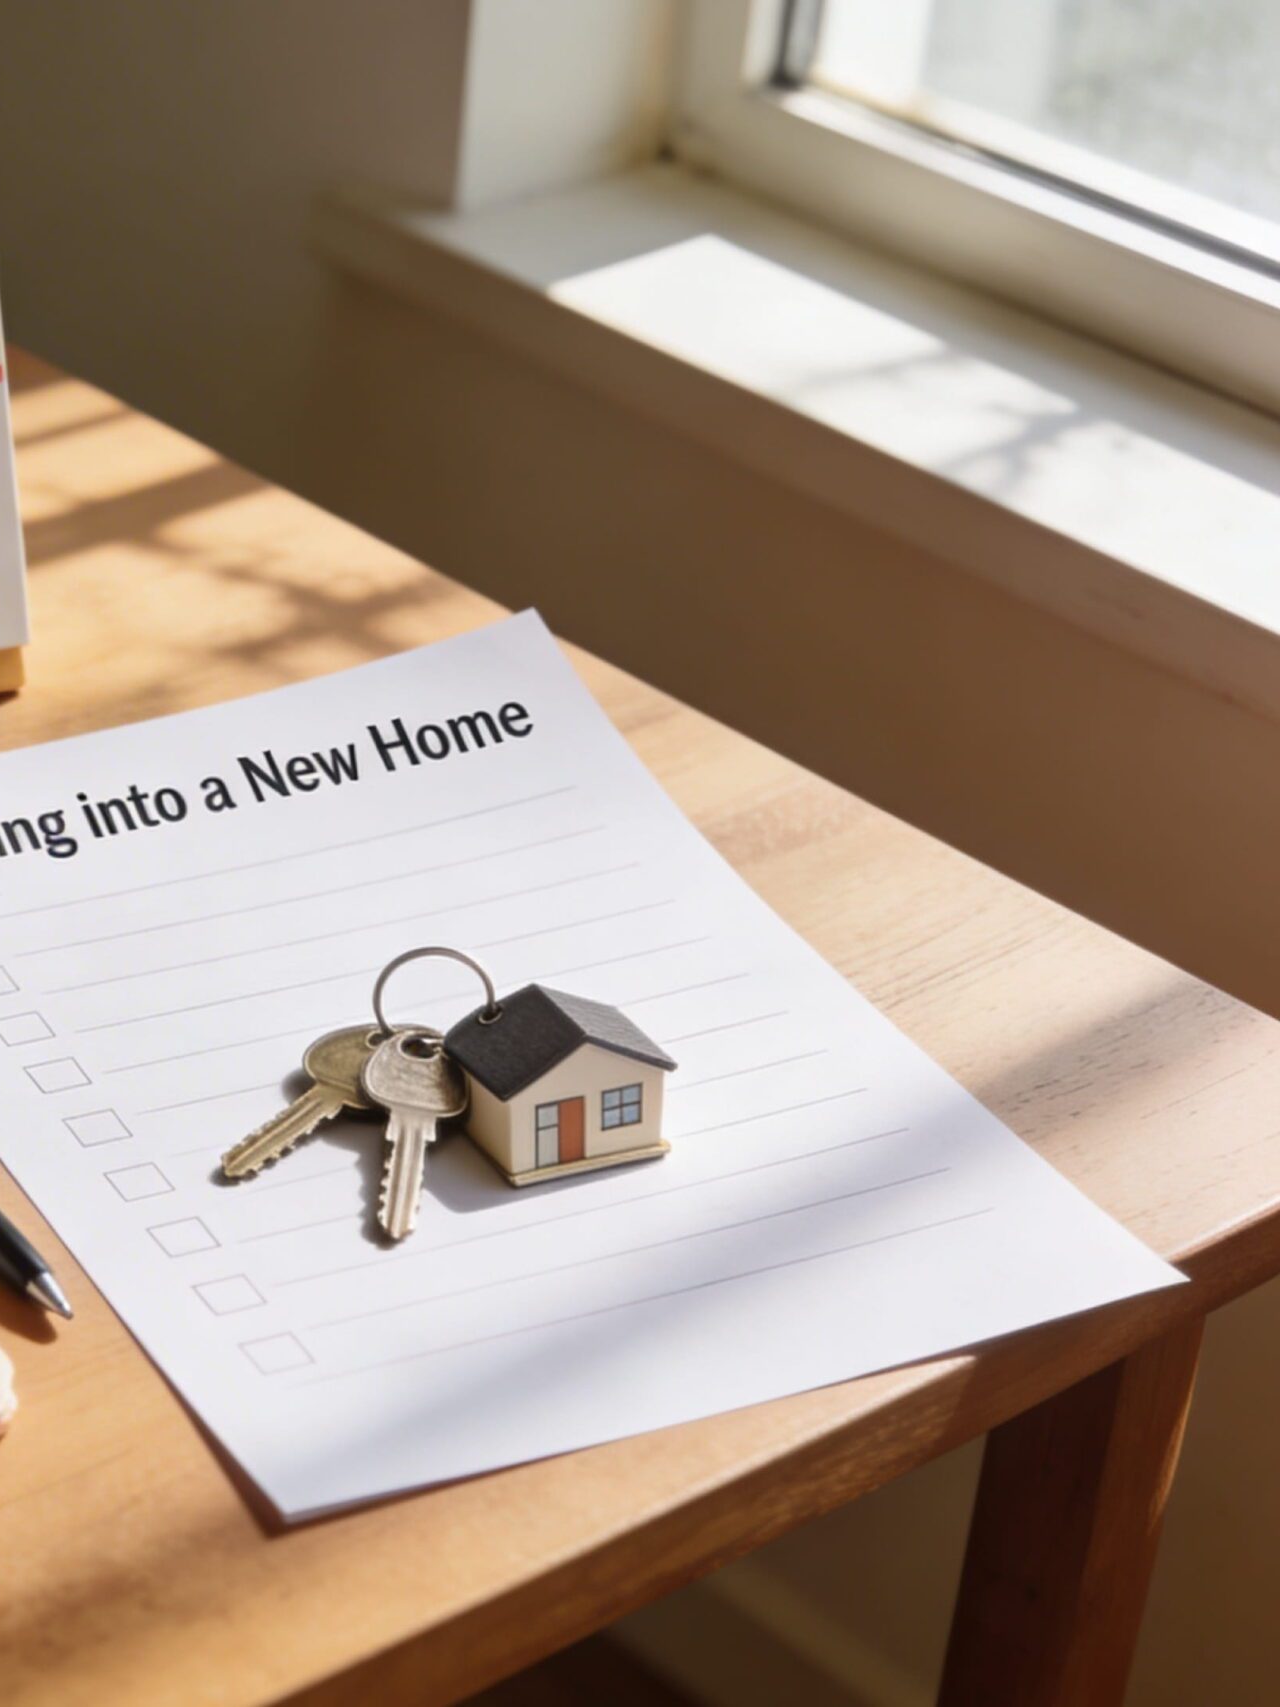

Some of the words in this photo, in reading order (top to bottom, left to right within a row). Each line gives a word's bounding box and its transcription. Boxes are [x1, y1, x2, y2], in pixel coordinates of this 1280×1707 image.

[76, 785, 187, 838] into
[200, 777, 237, 812] a
[237, 743, 359, 803] New
[366, 702, 534, 772] Home
